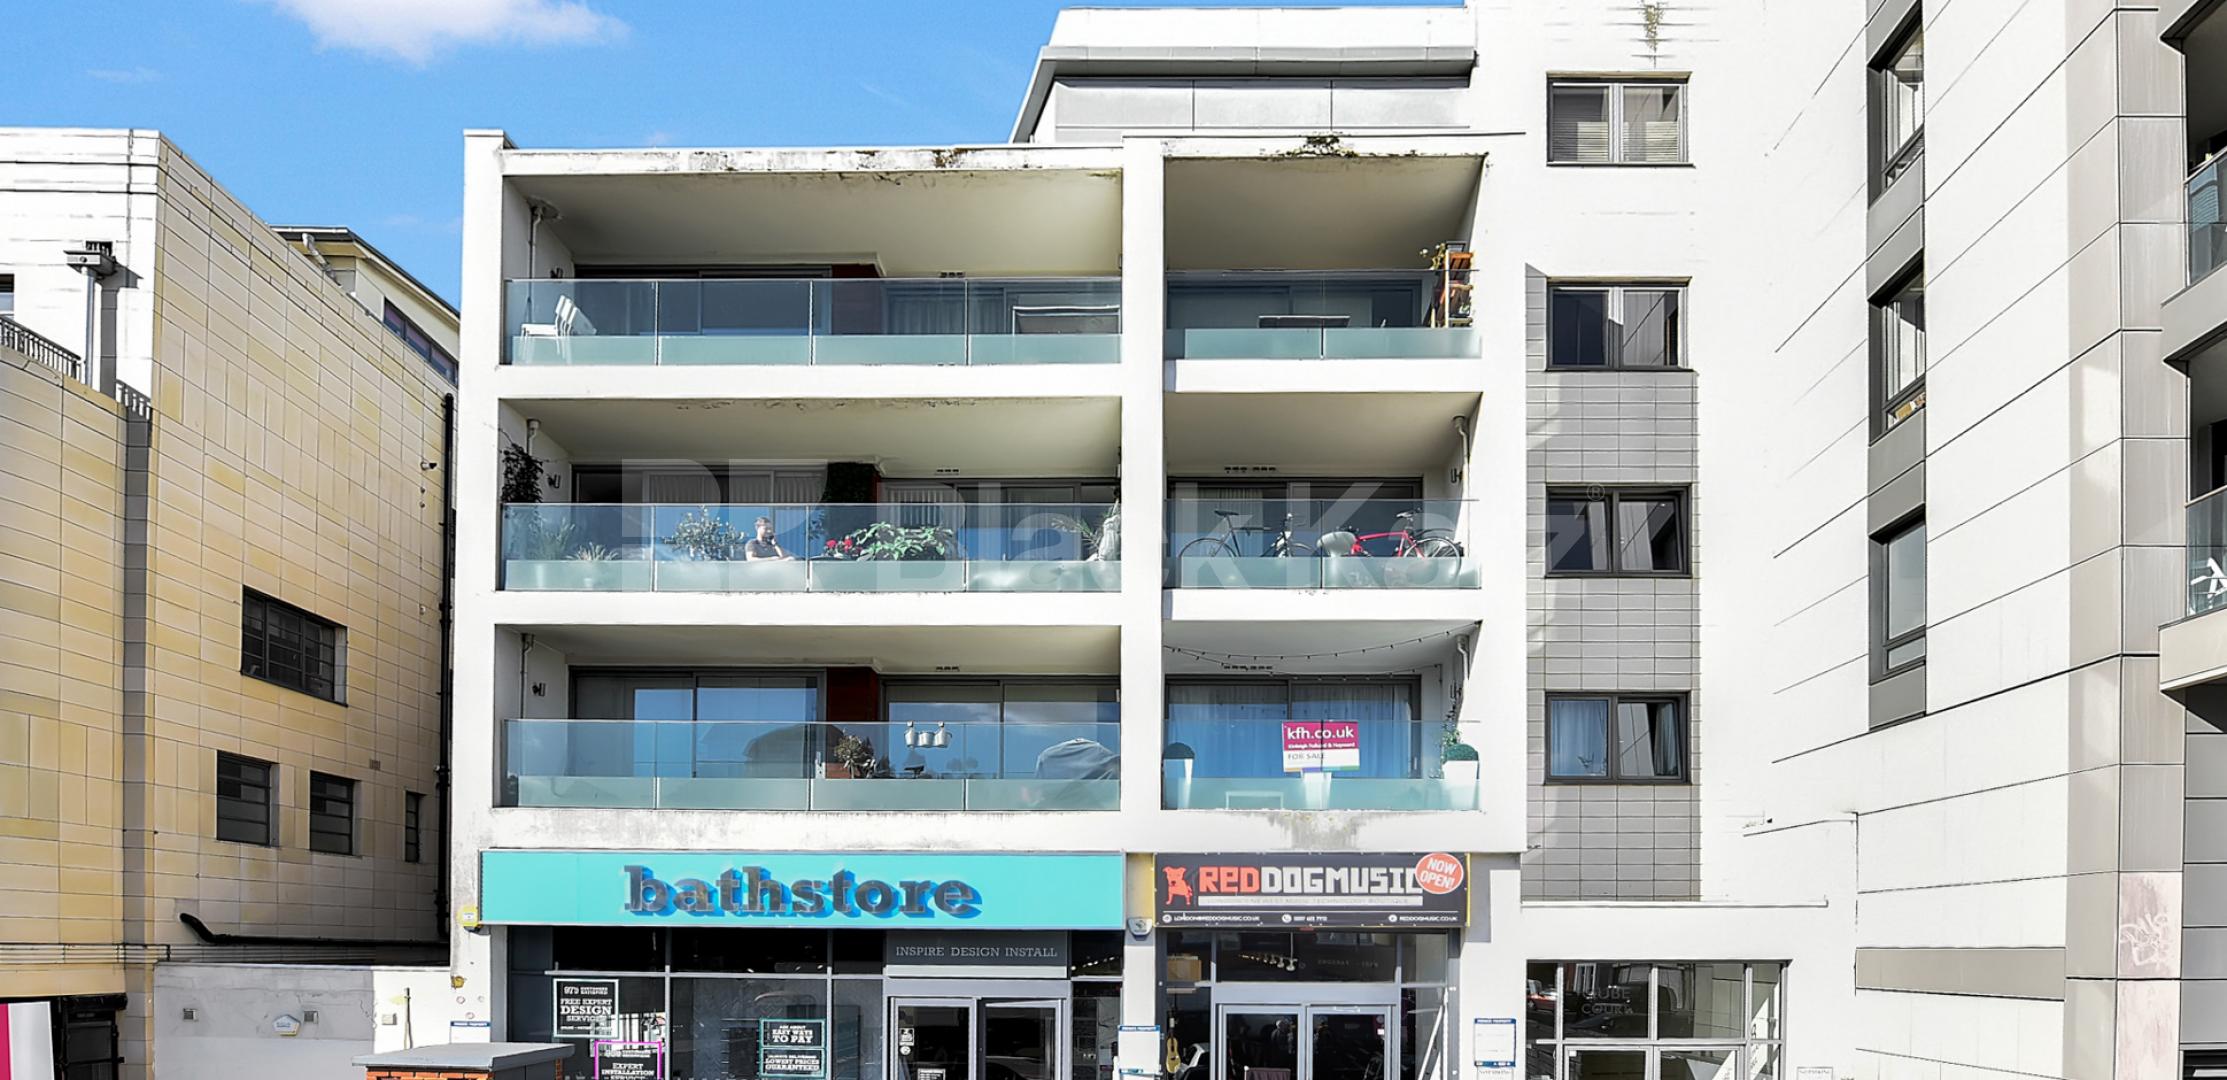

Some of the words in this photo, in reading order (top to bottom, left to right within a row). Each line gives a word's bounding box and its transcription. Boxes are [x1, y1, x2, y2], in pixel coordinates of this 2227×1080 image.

[1287, 726, 1354, 739] kfh.co.uk
[1288, 753, 1304, 761] FOR
[1306, 752, 1325, 760] SALE
[1427, 857, 1458, 875] NOW
[1420, 870, 1456, 890] OPEN!
[624, 864, 983, 918] bathstore
[896, 946, 945, 957] INSPIRE
[951, 947, 1000, 957] DESIGN
[1005, 947, 1058, 958] INSTALL
[560, 1005, 613, 1015] DESIGN
[773, 1035, 789, 1043] TO
[790, 1035, 813, 1043] PAY
